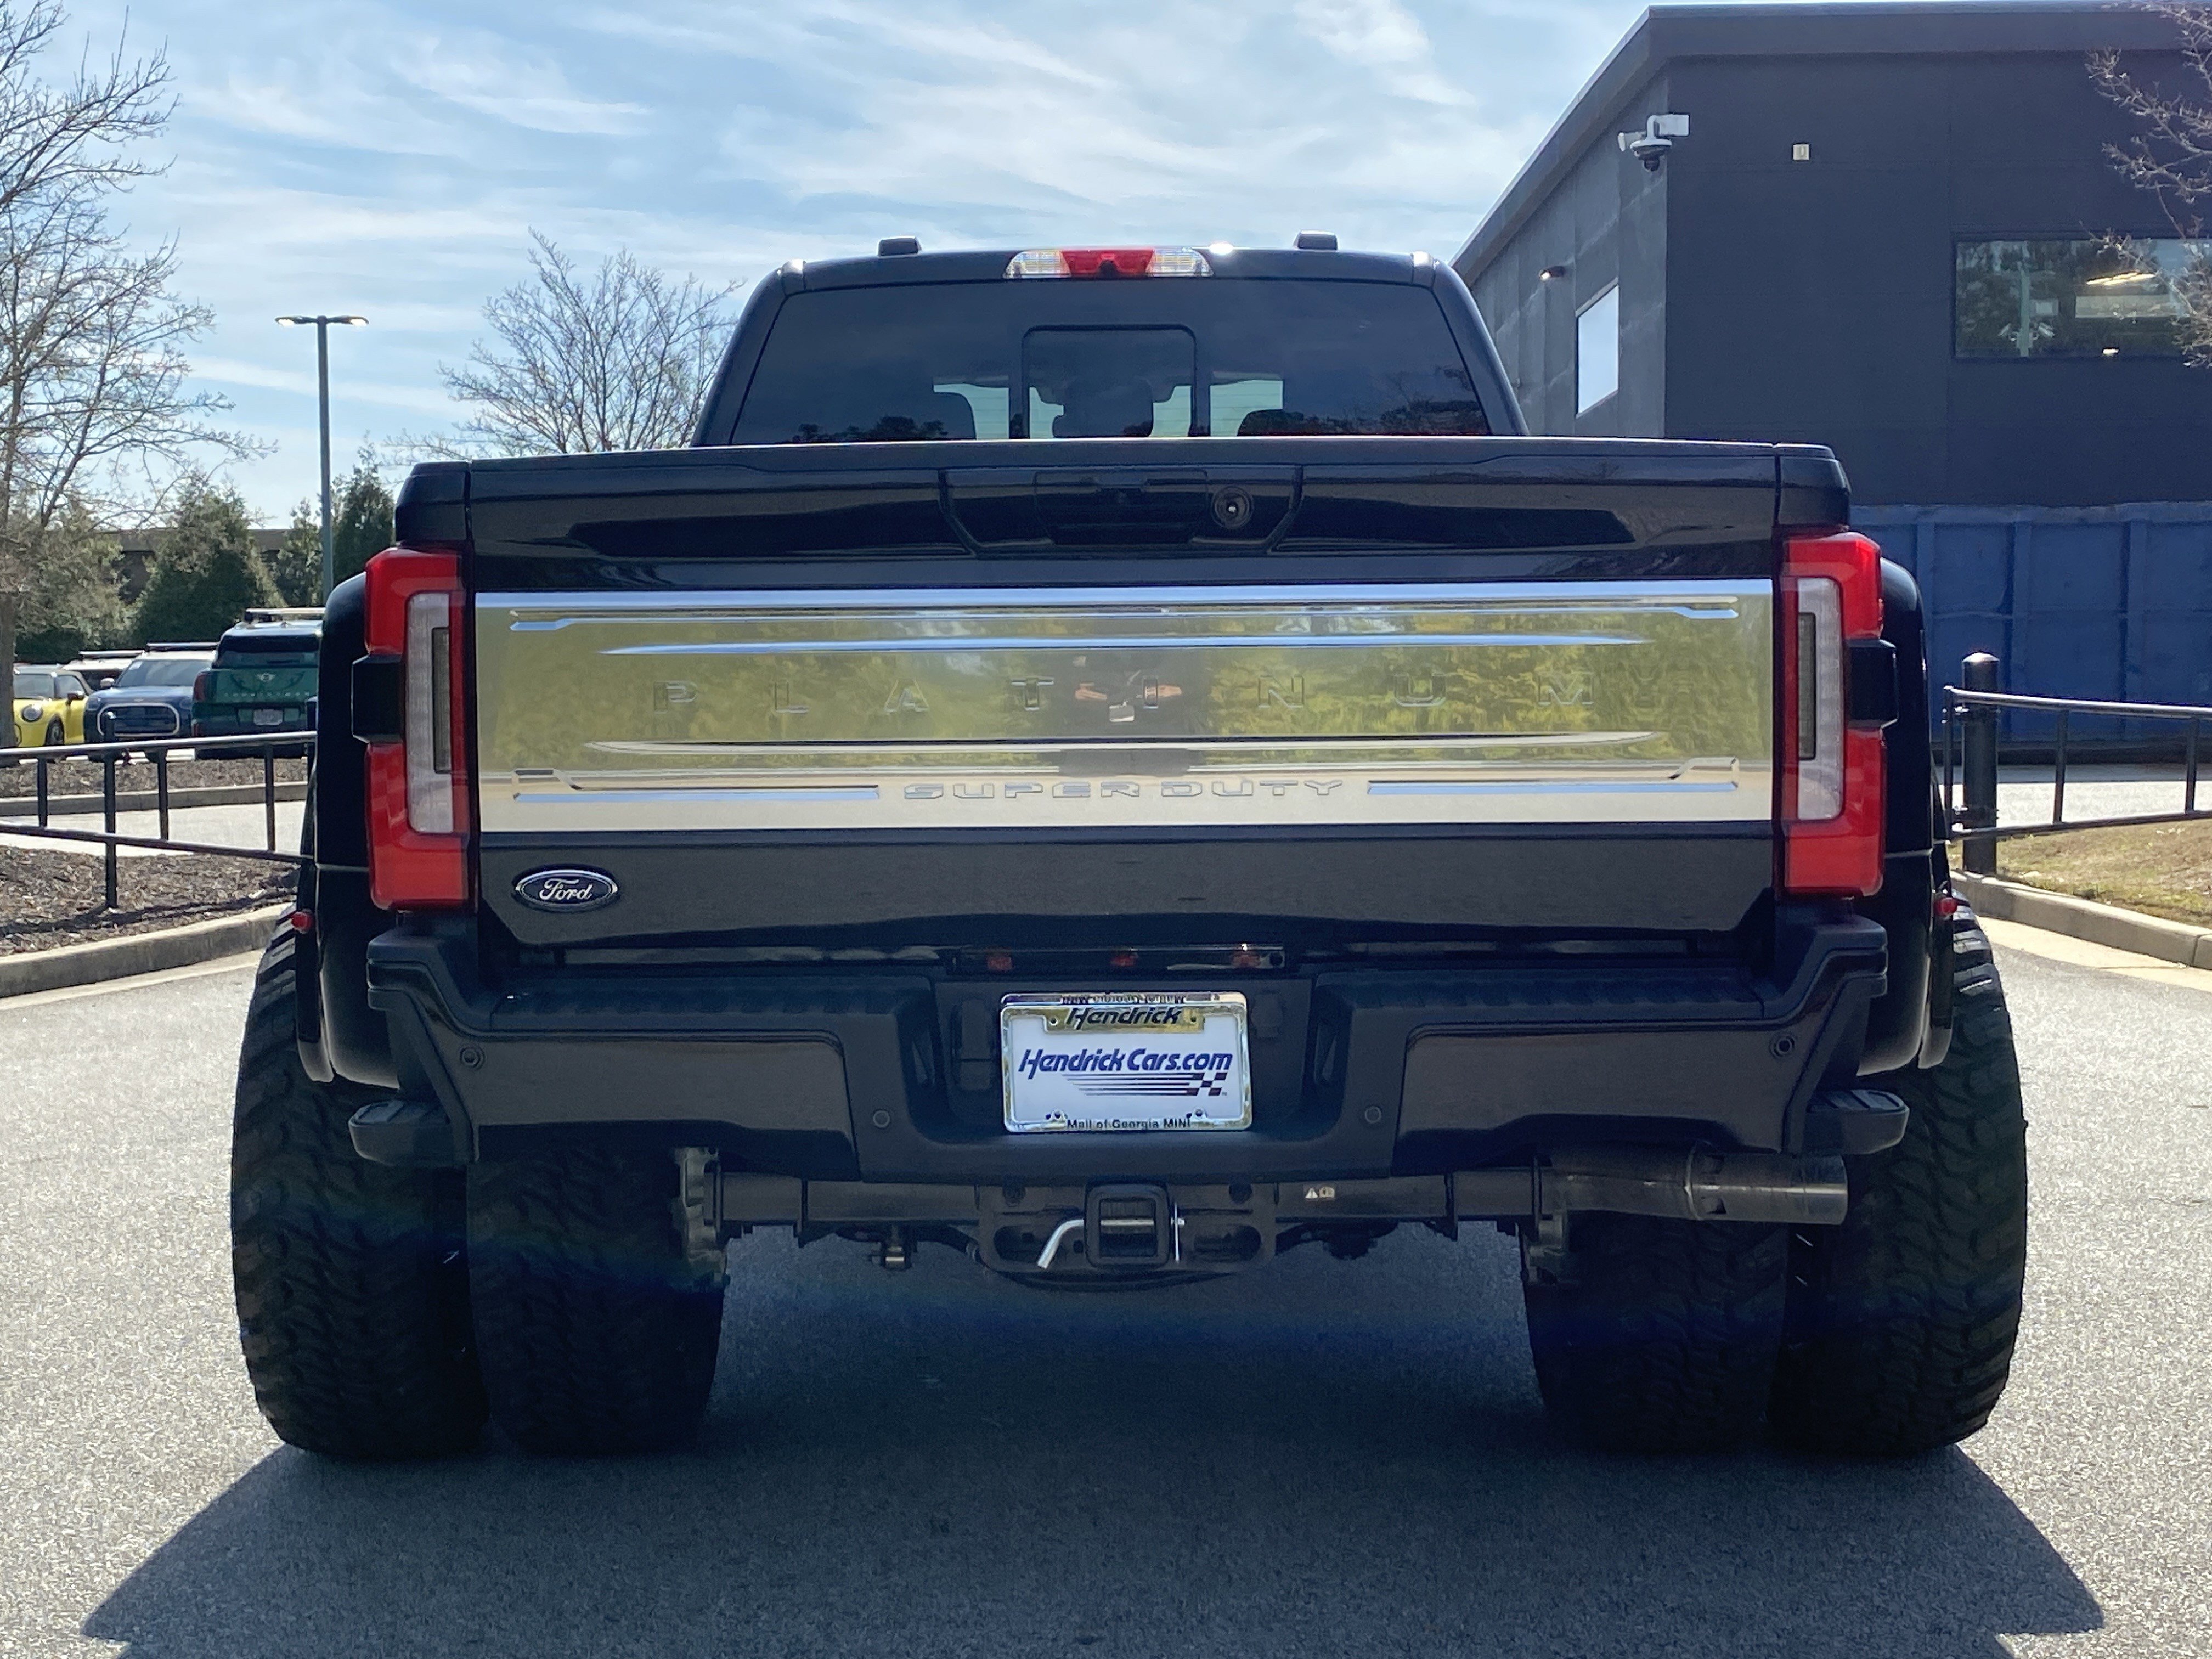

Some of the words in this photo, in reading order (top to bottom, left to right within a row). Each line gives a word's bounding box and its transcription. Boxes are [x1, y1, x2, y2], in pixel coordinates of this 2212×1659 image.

[653, 672, 1594, 715] PLATINUM
[904, 780, 1140, 799] SUPER
[1161, 779, 1343, 798] DUTY
[539, 878, 593, 900] Ford
[1066, 1007, 1182, 1030] Hendrick
[1066, 1119, 1092, 1129] Mall
[1096, 1119, 1107, 1129] of
[1112, 1119, 1159, 1131] Georgia
[1163, 1118, 1190, 1128] MINI
